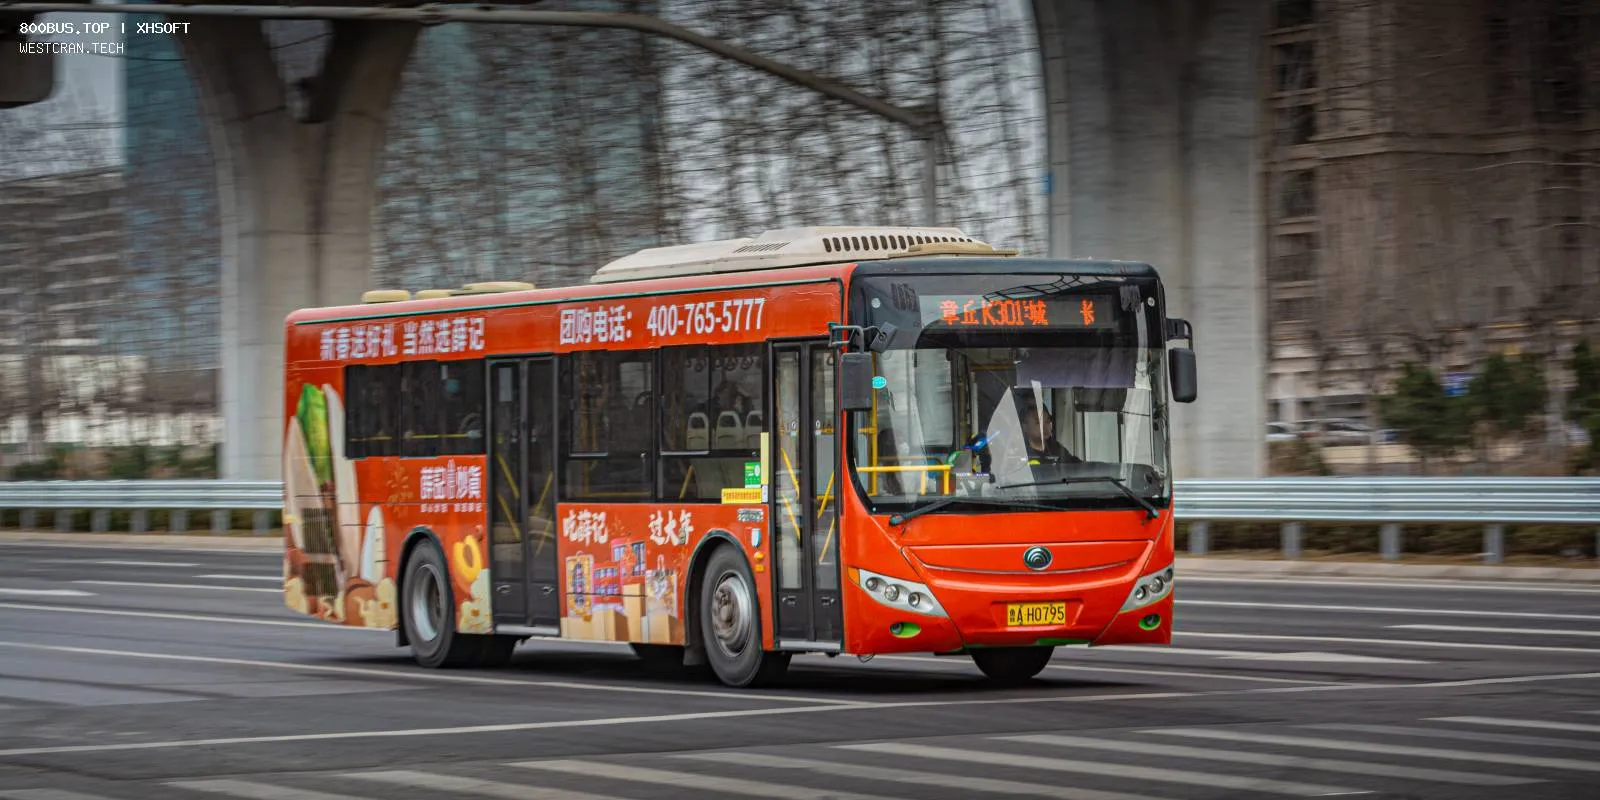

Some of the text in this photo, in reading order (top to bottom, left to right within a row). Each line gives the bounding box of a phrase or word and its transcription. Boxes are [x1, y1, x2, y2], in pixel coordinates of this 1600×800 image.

[646, 297, 765, 337] 400-765-5777
[320, 316, 485, 361] 新春送好礼 当然选薛记
